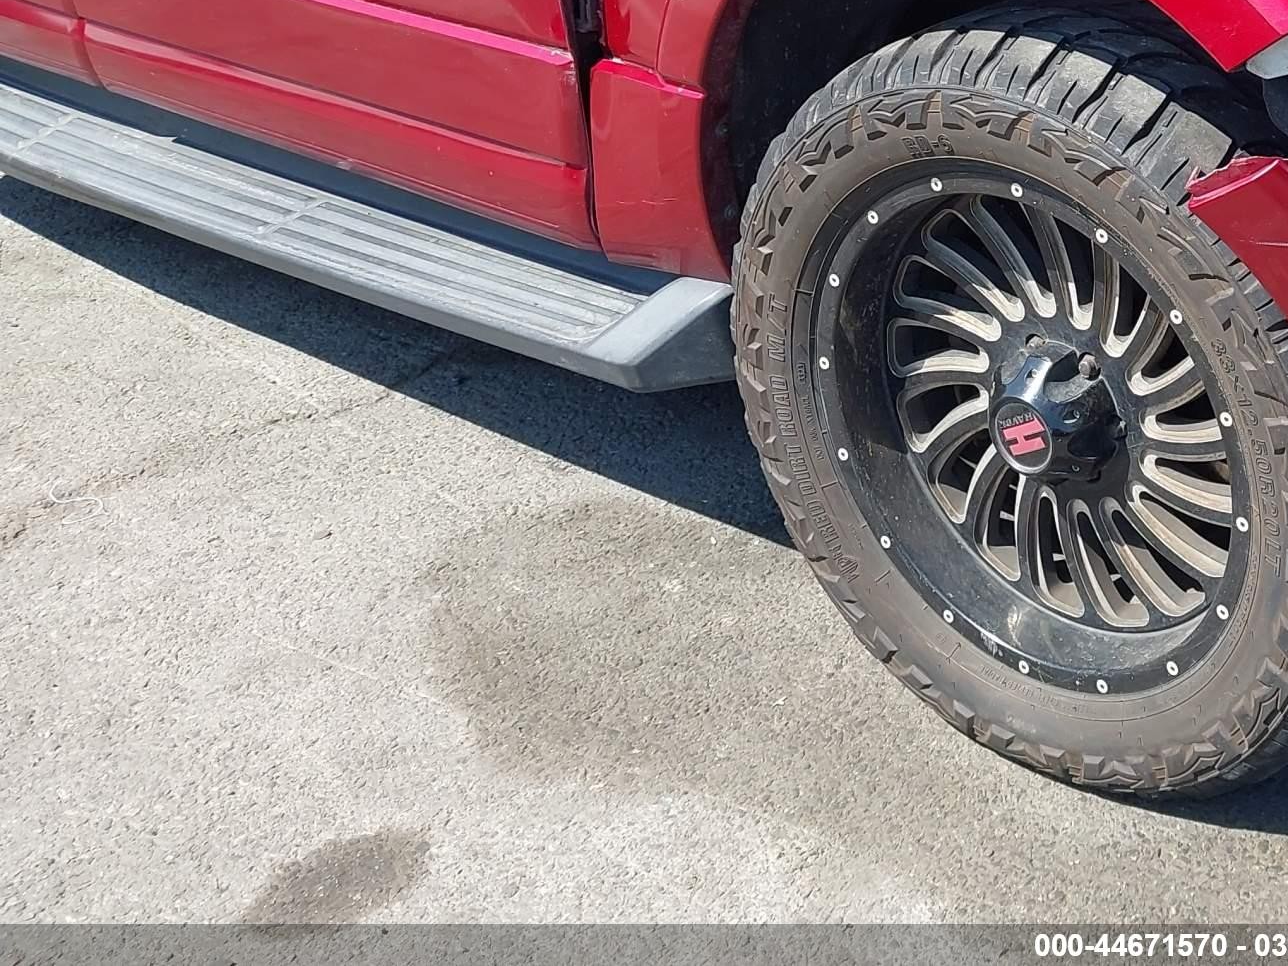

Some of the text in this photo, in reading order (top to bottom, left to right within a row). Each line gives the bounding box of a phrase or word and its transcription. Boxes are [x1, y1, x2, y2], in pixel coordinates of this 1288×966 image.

[766, 292, 788, 362] M/T
[769, 375, 798, 437] ROAD
[784, 442, 817, 497] DIRT
